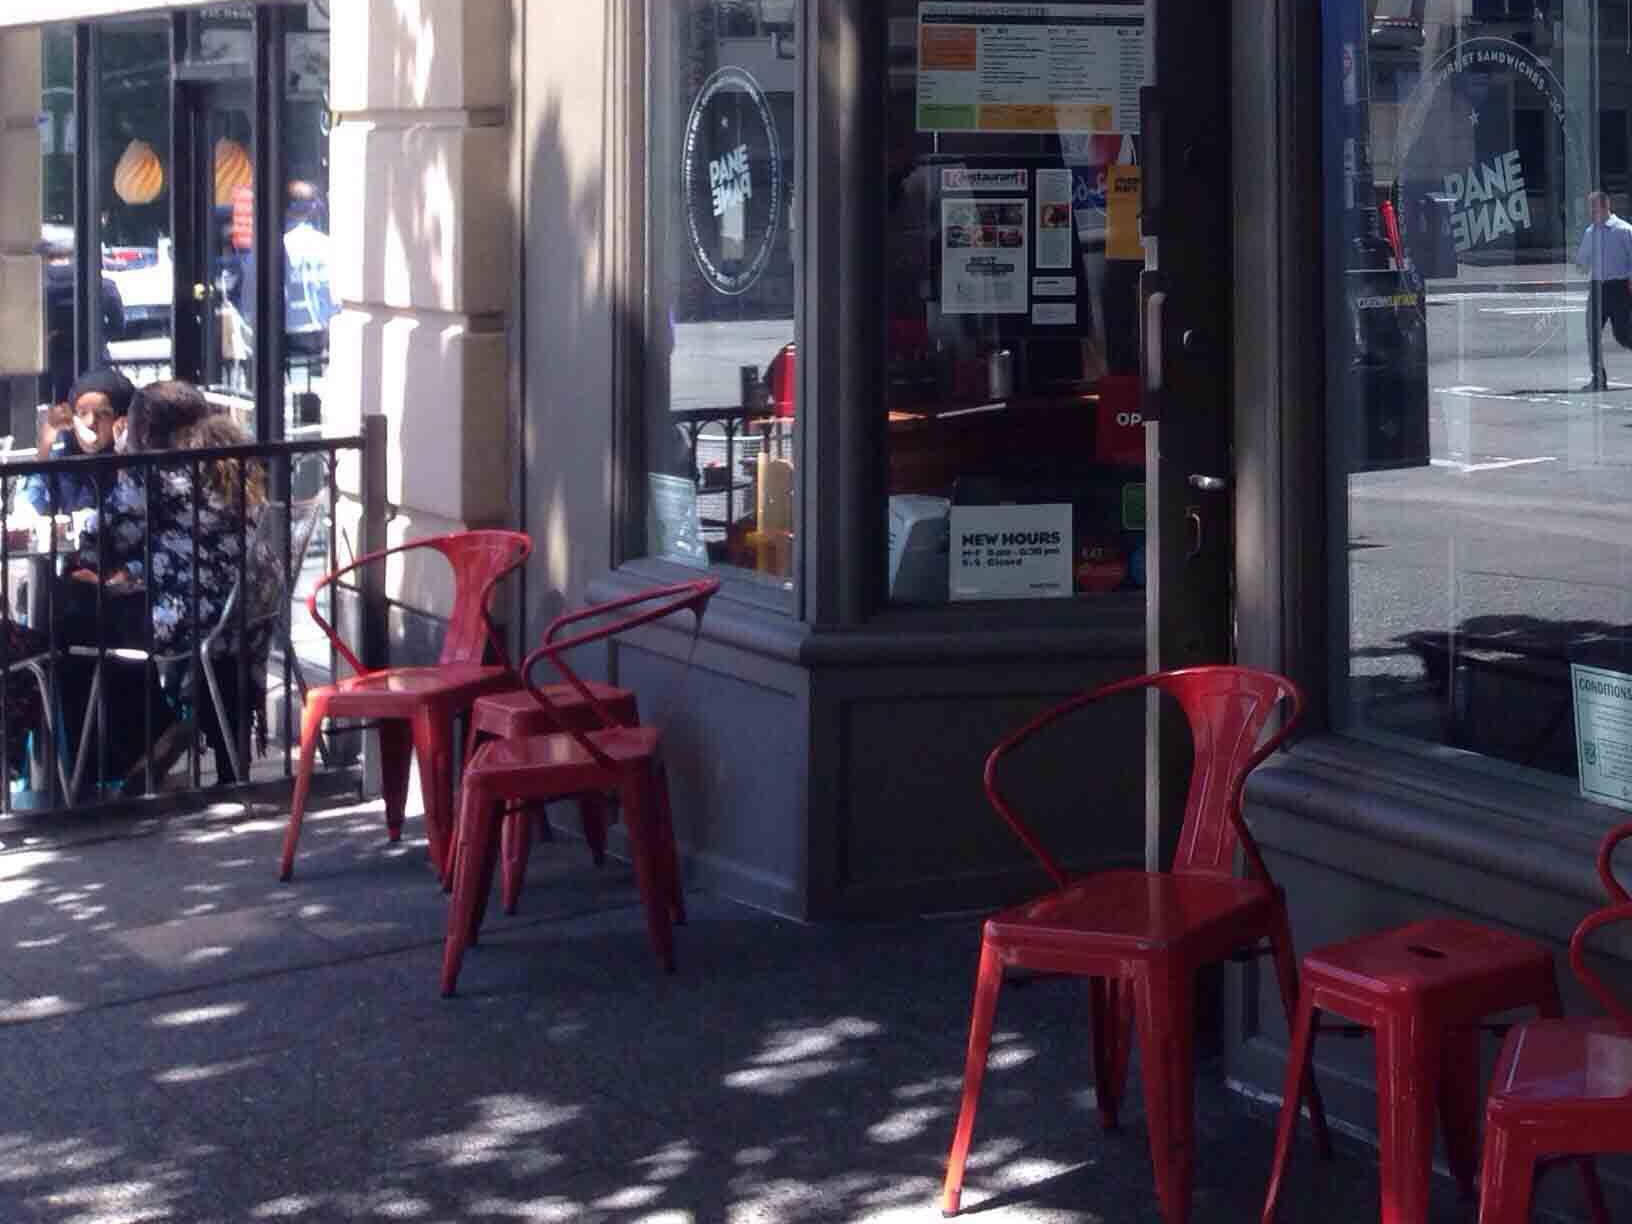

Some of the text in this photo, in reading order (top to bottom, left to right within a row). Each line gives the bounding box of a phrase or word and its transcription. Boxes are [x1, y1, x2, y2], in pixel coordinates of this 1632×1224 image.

[709, 143, 750, 188] PANE
[1443, 150, 1525, 207] PANE
[962, 531, 1061, 547] NEW HOURS
